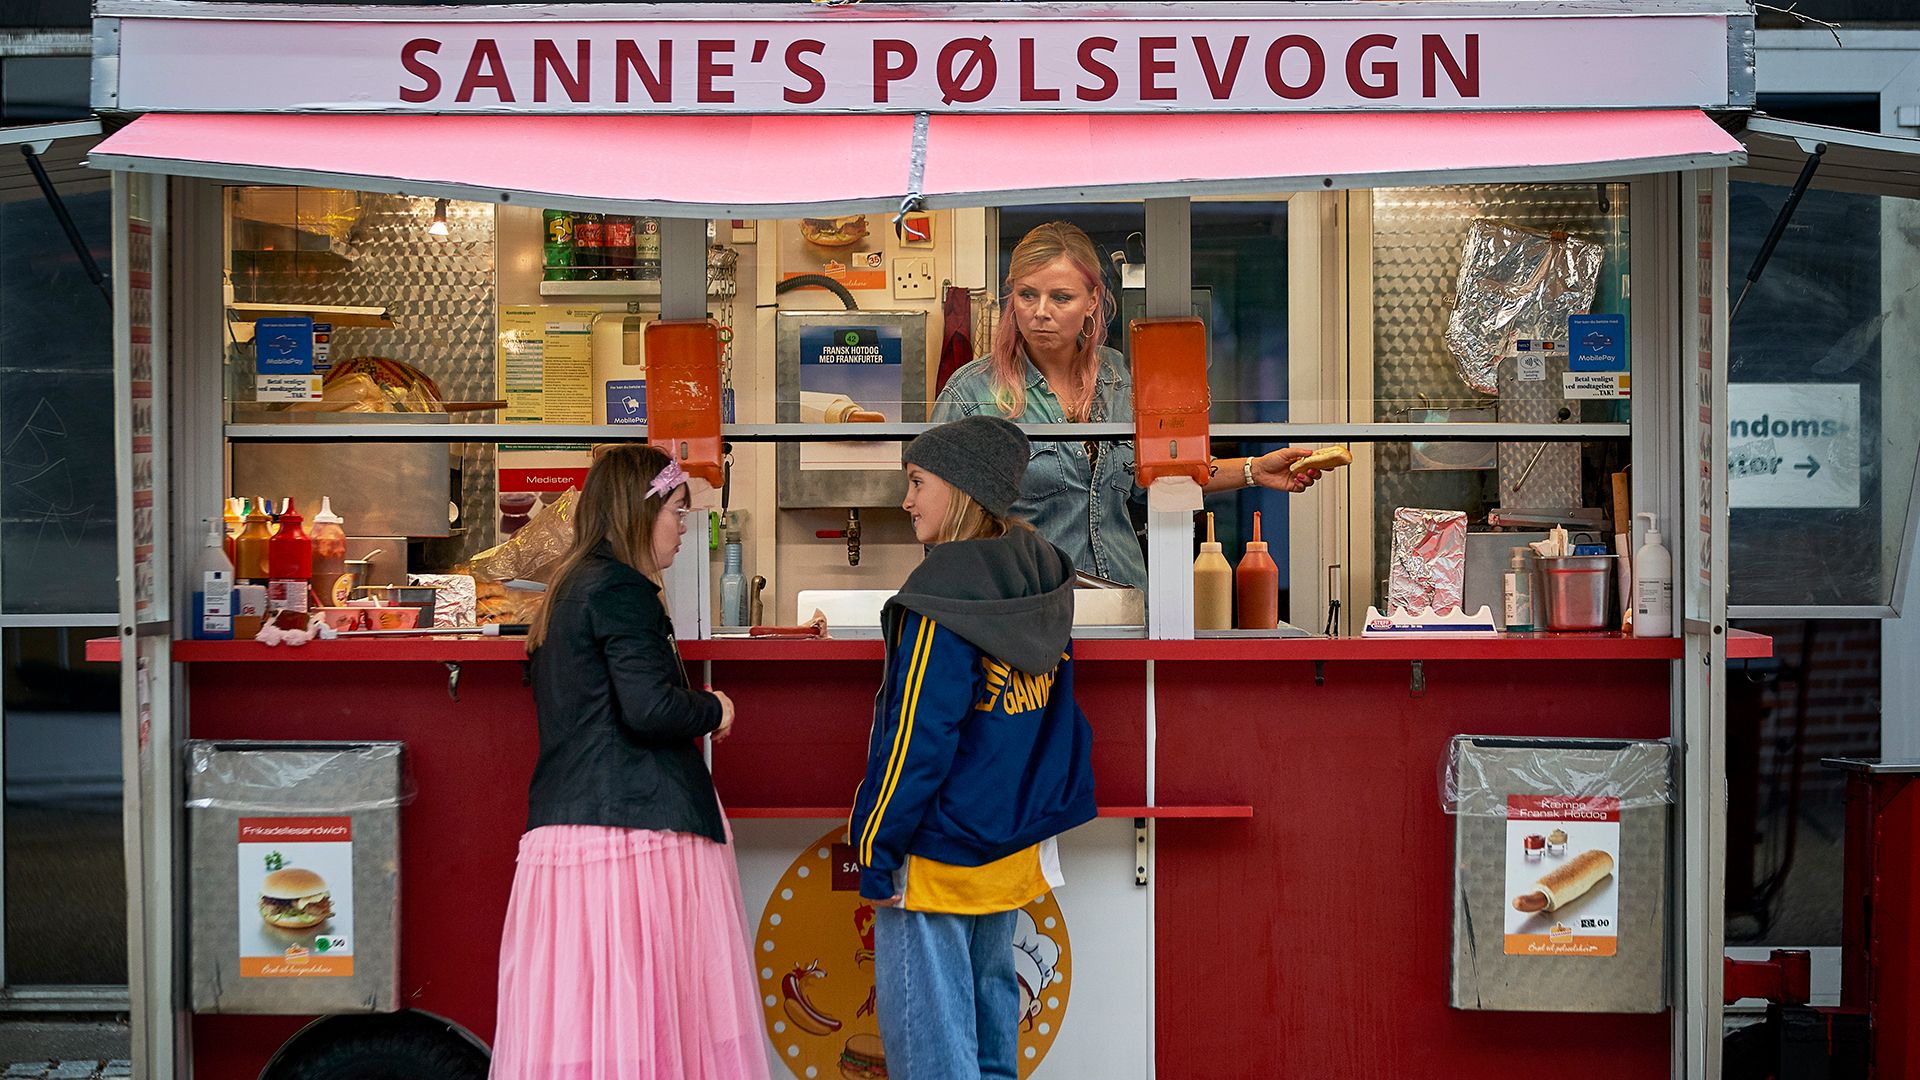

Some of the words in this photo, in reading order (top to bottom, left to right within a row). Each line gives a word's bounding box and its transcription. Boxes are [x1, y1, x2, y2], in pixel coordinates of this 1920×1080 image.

[400, 37, 827, 104] SANNE’S
[873, 33, 1479, 105] PØLSEVOGN
[846, 334, 857, 343] 42
[823, 346, 850, 355] FRANSK
[851, 346, 879, 355] HOTDOG
[265, 358, 304, 366] MobilePay
[819, 355, 835, 364] MED
[836, 355, 883, 364] FRANKFURTER
[1578, 354, 1616, 362] MobilePay
[1576, 383, 1614, 391] modtagelsen
[613, 416, 648, 424] MobilePay
[526, 475, 574, 484] Medister
[1520, 808, 1560, 818] Fransk
[1564, 809, 1608, 820] Hotdog
[242, 825, 348, 836] Frikadellesandwich
